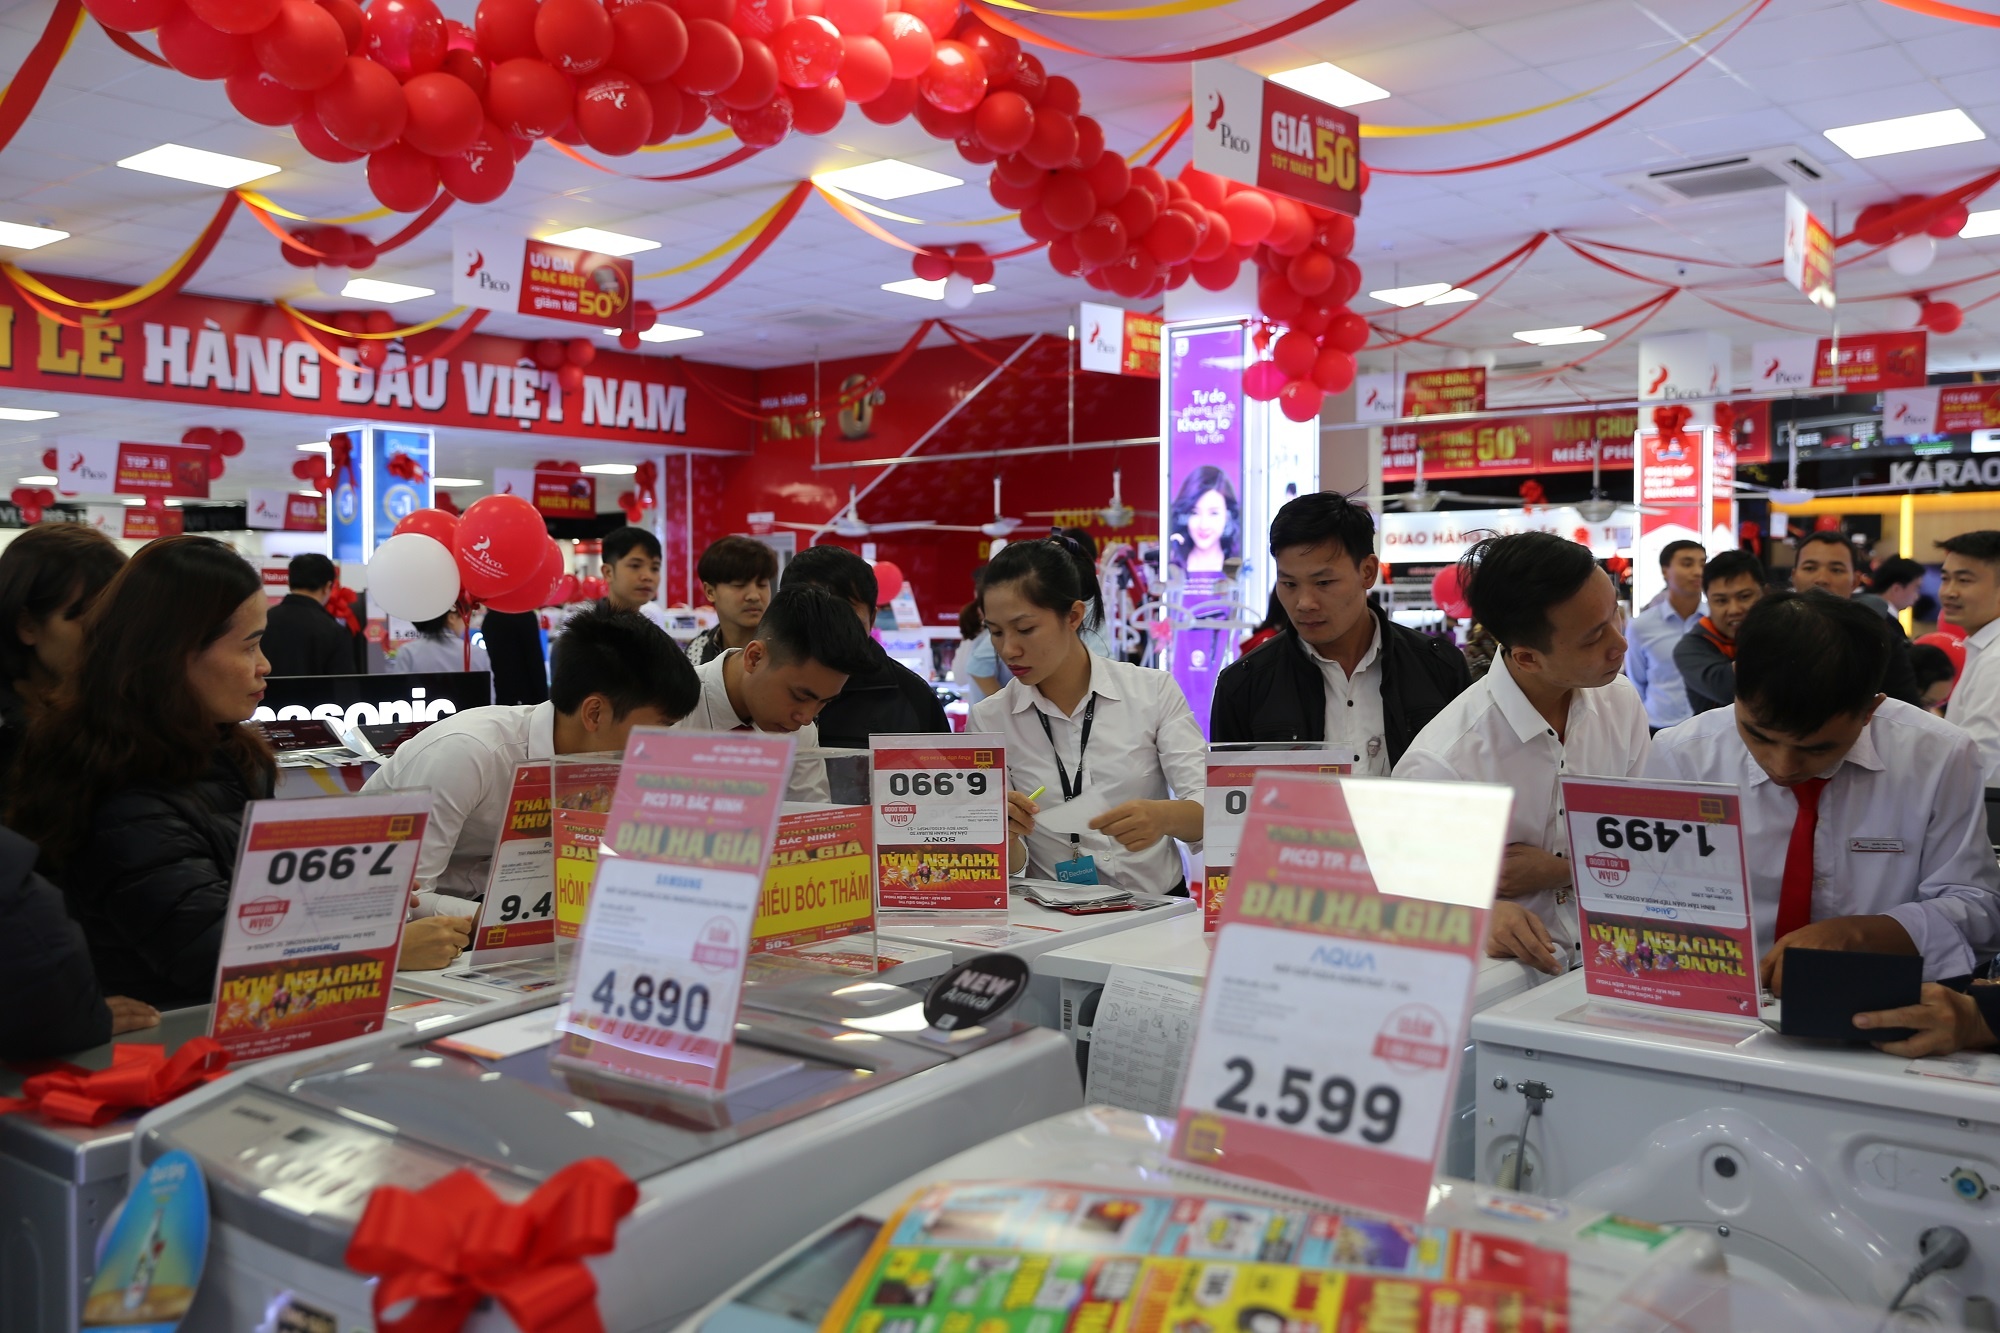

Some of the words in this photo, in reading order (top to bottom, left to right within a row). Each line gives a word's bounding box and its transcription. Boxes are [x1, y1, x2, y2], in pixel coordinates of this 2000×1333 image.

[1271, 111, 1314, 160] GIÁ
[534, 295, 561, 312] giảm
[562, 298, 577, 313] tới
[143, 317, 320, 399] HÀNG
[336, 335, 449, 411] ĐẦU
[461, 358, 564, 428] VIỆT
[582, 376, 687, 433] NAM
[1191, 389, 1209, 405] Tự
[1211, 387, 1226, 404] do
[1177, 417, 1215, 433] Không
[1552, 418, 1590, 440] VẬN
[1477, 425, 1531, 461] 50%
[1552, 440, 1596, 463] MIỄN
[1603, 441, 1634, 460] PHÍ
[126, 456, 149, 468] TOP
[1385, 531, 1428, 546] GIAO
[1432, 525, 1481, 545] HÀNG
[890, 773, 986, 796] 6.990
[891, 815, 908, 826] GIẢM
[575, 833, 596, 842] PICO
[807, 832, 836, 842] NINH
[1597, 816, 1716, 857] 1.499
[816, 839, 863, 860] GIÁ
[268, 843, 398, 884] 7.990
[880, 852, 919, 872] MẠI
[923, 853, 1000, 871] KHUYẾN
[1068, 867, 1094, 878] Electrolux
[949, 868, 1002, 883] THÁNG
[1598, 870, 1619, 882] GIẢM
[559, 872, 585, 907] HÒM
[795, 875, 826, 912] BỐC
[830, 870, 869, 905] THĂM
[499, 891, 555, 922] 9.4
[1646, 906, 1678, 920] Midea
[1701, 903, 1715, 912] BÌNH
[248, 916, 274, 930] GIẢM
[283, 942, 341, 958] Panasonic
[765, 939, 791, 950] 50%
[1588, 922, 1638, 955] MẠI
[1643, 929, 1743, 961] KHUYẾN
[1310, 945, 1377, 972] AQUA
[1677, 954, 1746, 977] THÁNG
[221, 974, 277, 1004] MẠI
[283, 960, 385, 997] KHUYẾN
[952, 969, 1016, 996] NEW
[316, 982, 381, 1007] THÁNG
[591, 969, 710, 1033] 4.890
[941, 987, 996, 1011] Arrival
[1214, 1056, 1402, 1145] 2.599
